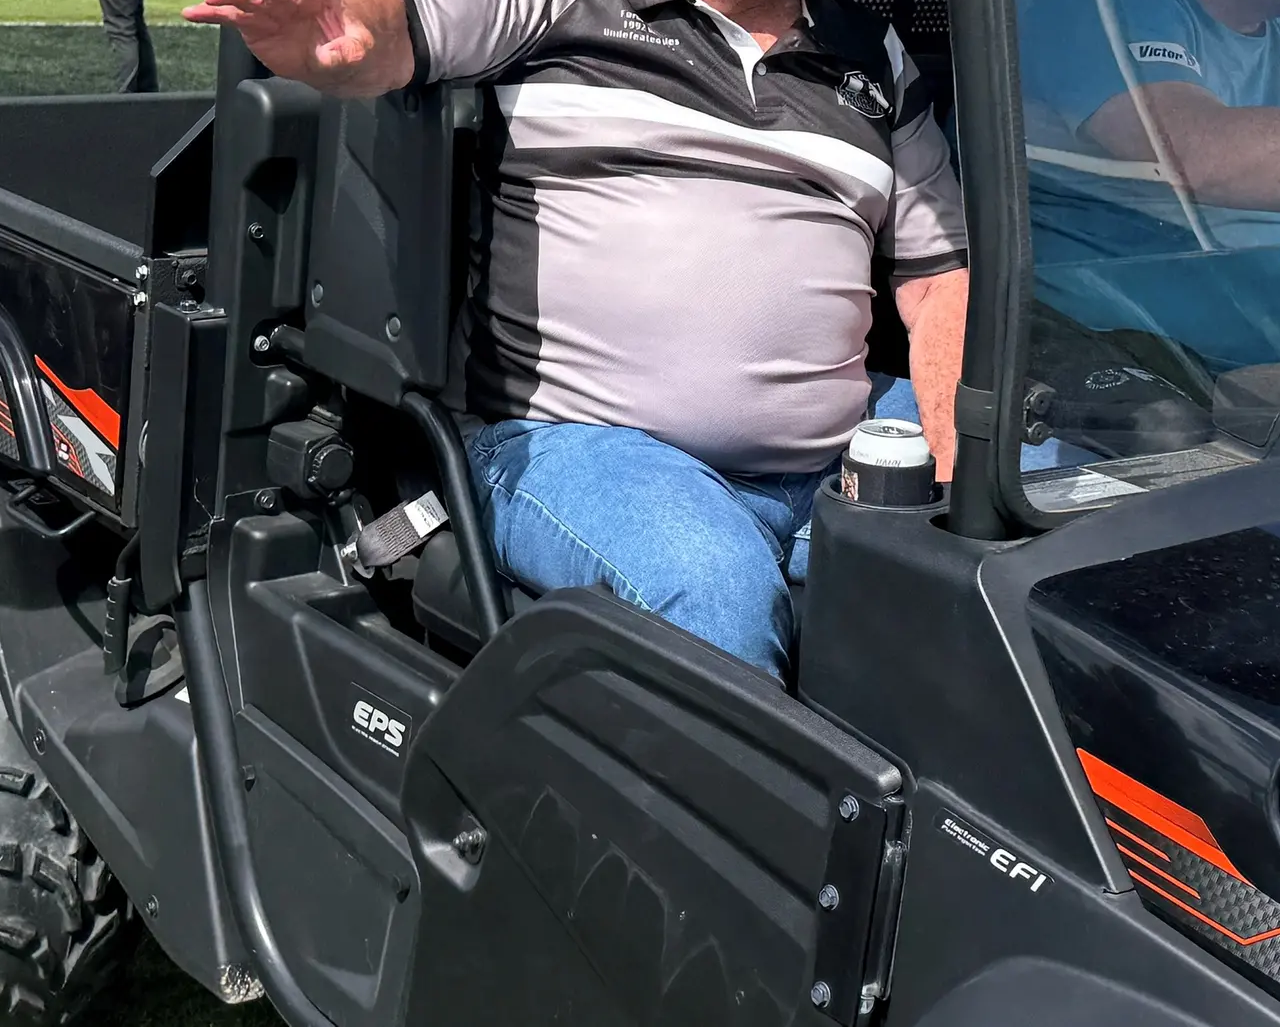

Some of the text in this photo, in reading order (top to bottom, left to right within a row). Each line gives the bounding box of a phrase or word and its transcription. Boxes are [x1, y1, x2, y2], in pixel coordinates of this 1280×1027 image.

[353, 700, 406, 747] EPS
[944, 818, 990, 852] Electronic
[989, 848, 1047, 892] EFI
